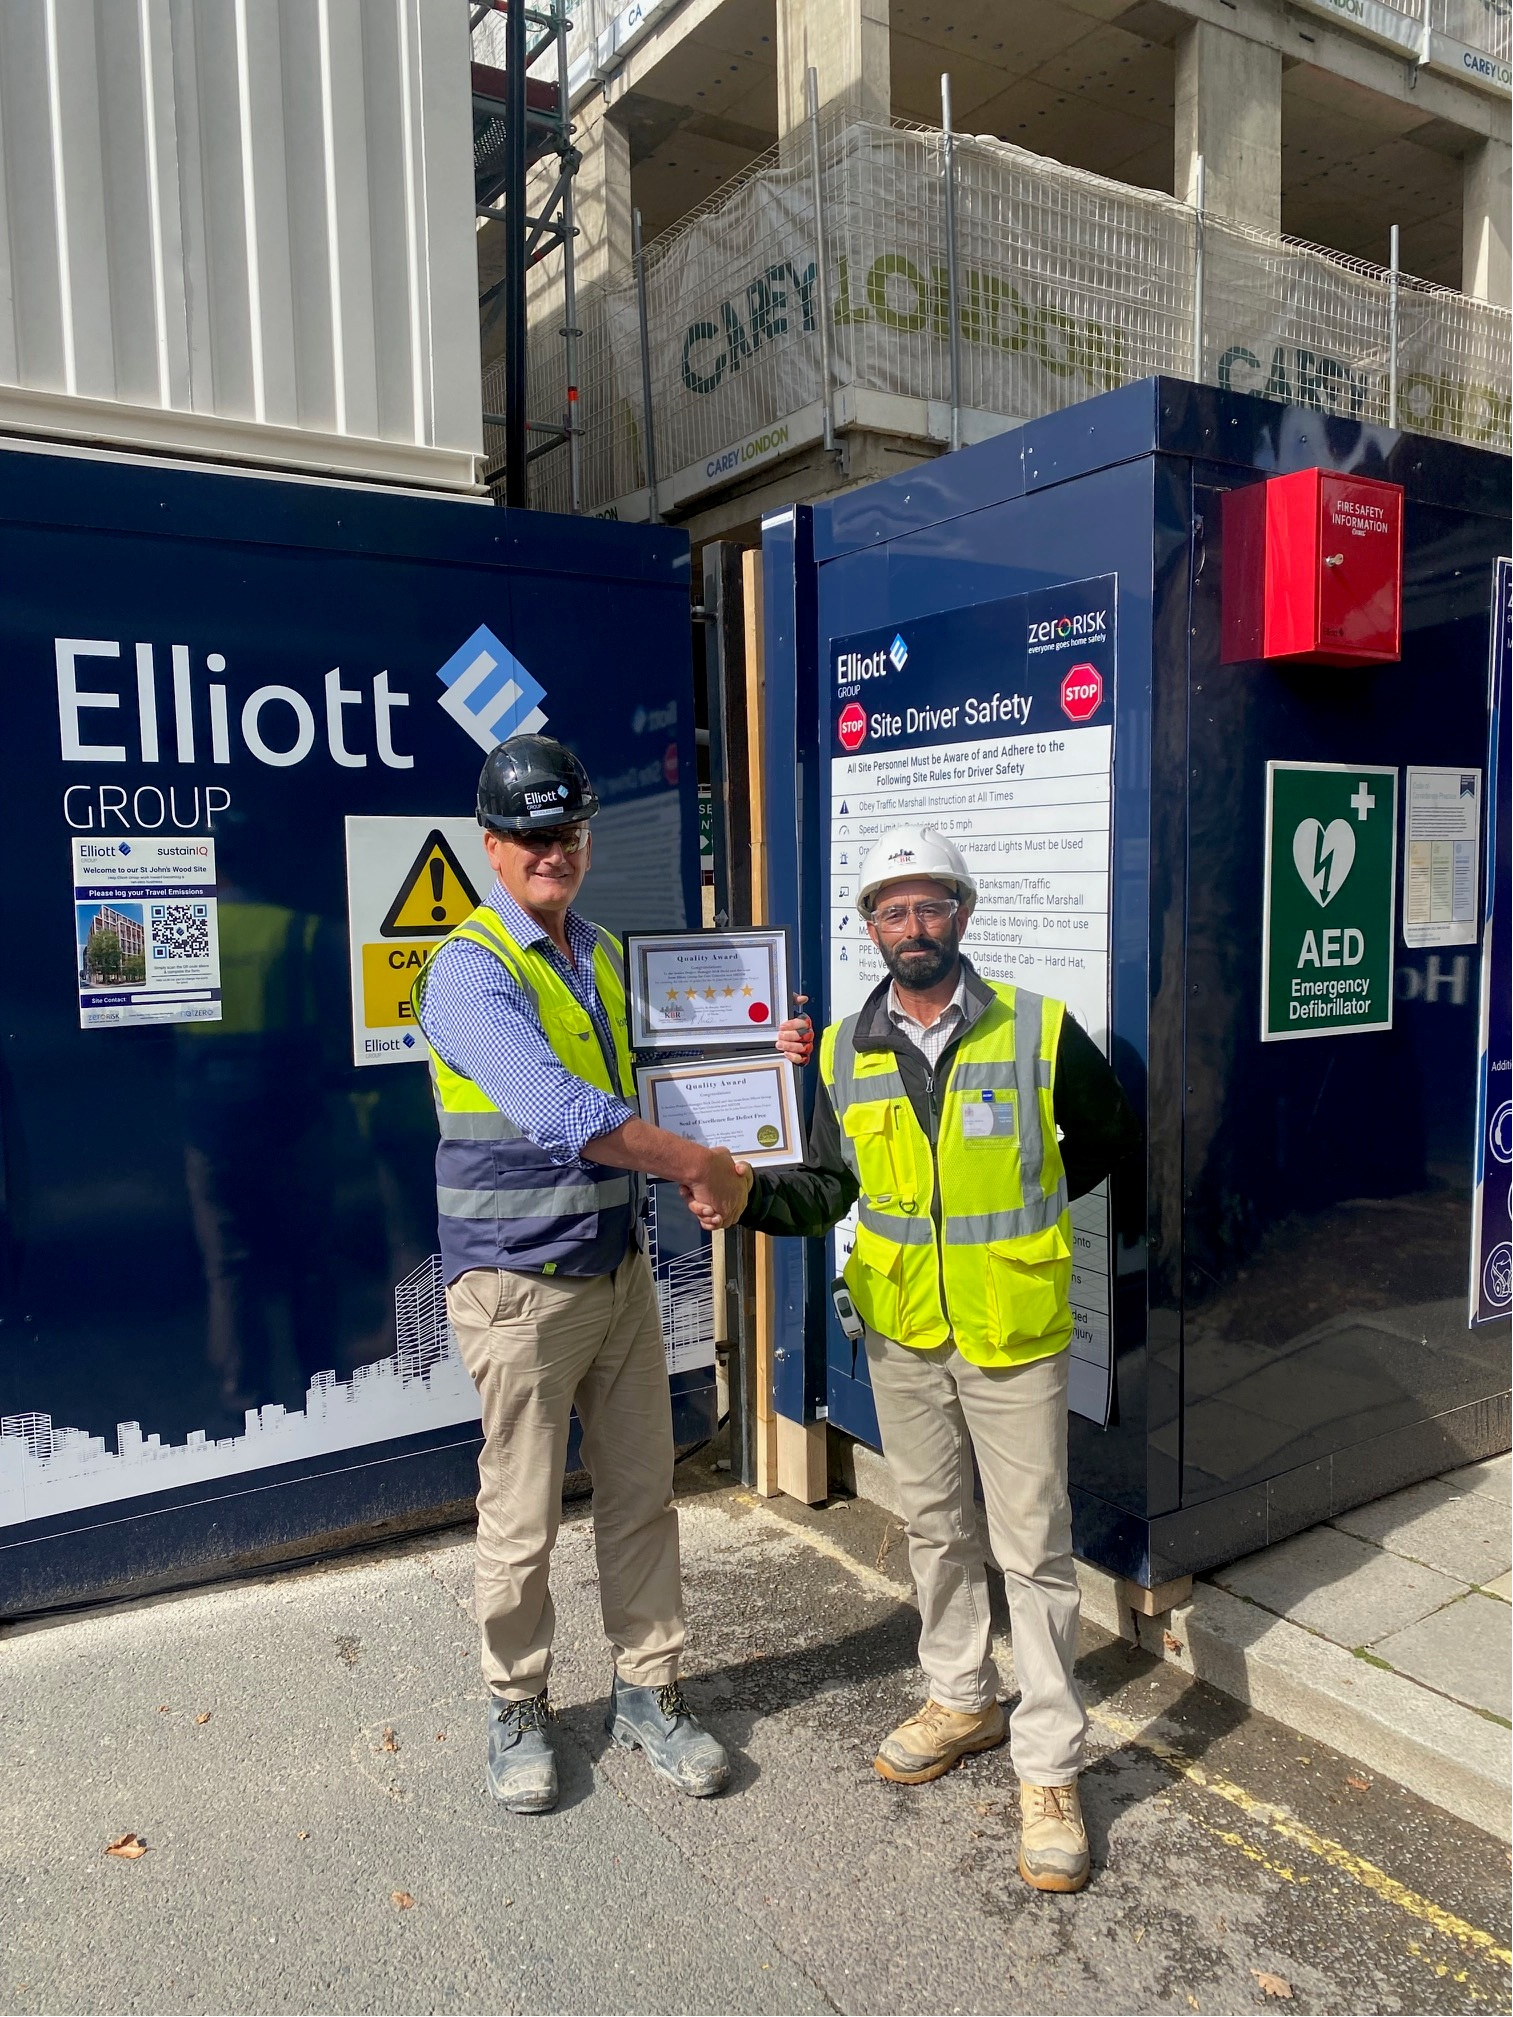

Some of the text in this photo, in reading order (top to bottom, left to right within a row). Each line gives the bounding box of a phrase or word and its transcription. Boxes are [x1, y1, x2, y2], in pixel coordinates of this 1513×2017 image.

[1464, 52, 1496, 78] CAREY
[706, 425, 789, 478] CAREY LONDON
[1337, 500, 1384, 519] FIRE SAFETY
[1332, 513, 1388, 533] INFORMATION
[1028, 633, 1106, 655] everyone goes home safely
[837, 650, 887, 684] Elliott
[837, 684, 861, 698] GROUP
[1065, 684, 1098, 701] STOP
[55, 637, 415, 769] Elliott
[870, 694, 1033, 739] Site Driver Safety
[842, 719, 863, 734] STOP
[847, 741, 1065, 774] All Site Personnel Must be Aware of and Adhere to the
[876, 762, 1025, 788] Following Site Rules for Driver Safety
[524, 790, 557, 805] Elliott
[859, 791, 1014, 813] Obey Traffic Marshall Instruction at All Times
[63, 785, 231, 829] GROUP
[859, 824, 879, 835] Speed
[941, 821, 948, 830] to
[950, 820, 955, 829] 5
[956, 819, 973, 832] mph
[80, 844, 208, 857] Elliott sustainIQ
[969, 842, 996, 852] Hazard
[998, 841, 1022, 854] Lights
[1025, 840, 1046, 851] Must
[1048, 839, 1059, 850] be
[1061, 838, 1084, 849] Used
[980, 878, 1051, 890] Banksman/Traffic
[115, 889, 126, 897] log
[145, 888, 167, 896] Travel
[1046, 894, 1084, 906] Marshall
[970, 916, 1089, 930] Vehicle is Moving. Do not use
[983, 931, 1023, 945] Stationary
[1297, 928, 1365, 969] AED
[677, 953, 738, 963] Quality Award
[859, 945, 873, 955] PPE
[973, 951, 1002, 963] Outside
[1004, 953, 1017, 964] the
[1018, 953, 1035, 965] Cab
[1045, 955, 1065, 967] Hard
[1068, 956, 1086, 969] Hat,
[859, 959, 877, 969] Hi-vis
[859, 972, 880, 982] Shorts
[983, 967, 1015, 979] Glasses.
[1291, 977, 1370, 998] Emergency
[1289, 998, 1371, 1020] Defibrillator
[365, 1039, 400, 1052] Elliott
[686, 1078, 747, 1091] Quality Award
[698, 1117, 726, 1125] Excellence
